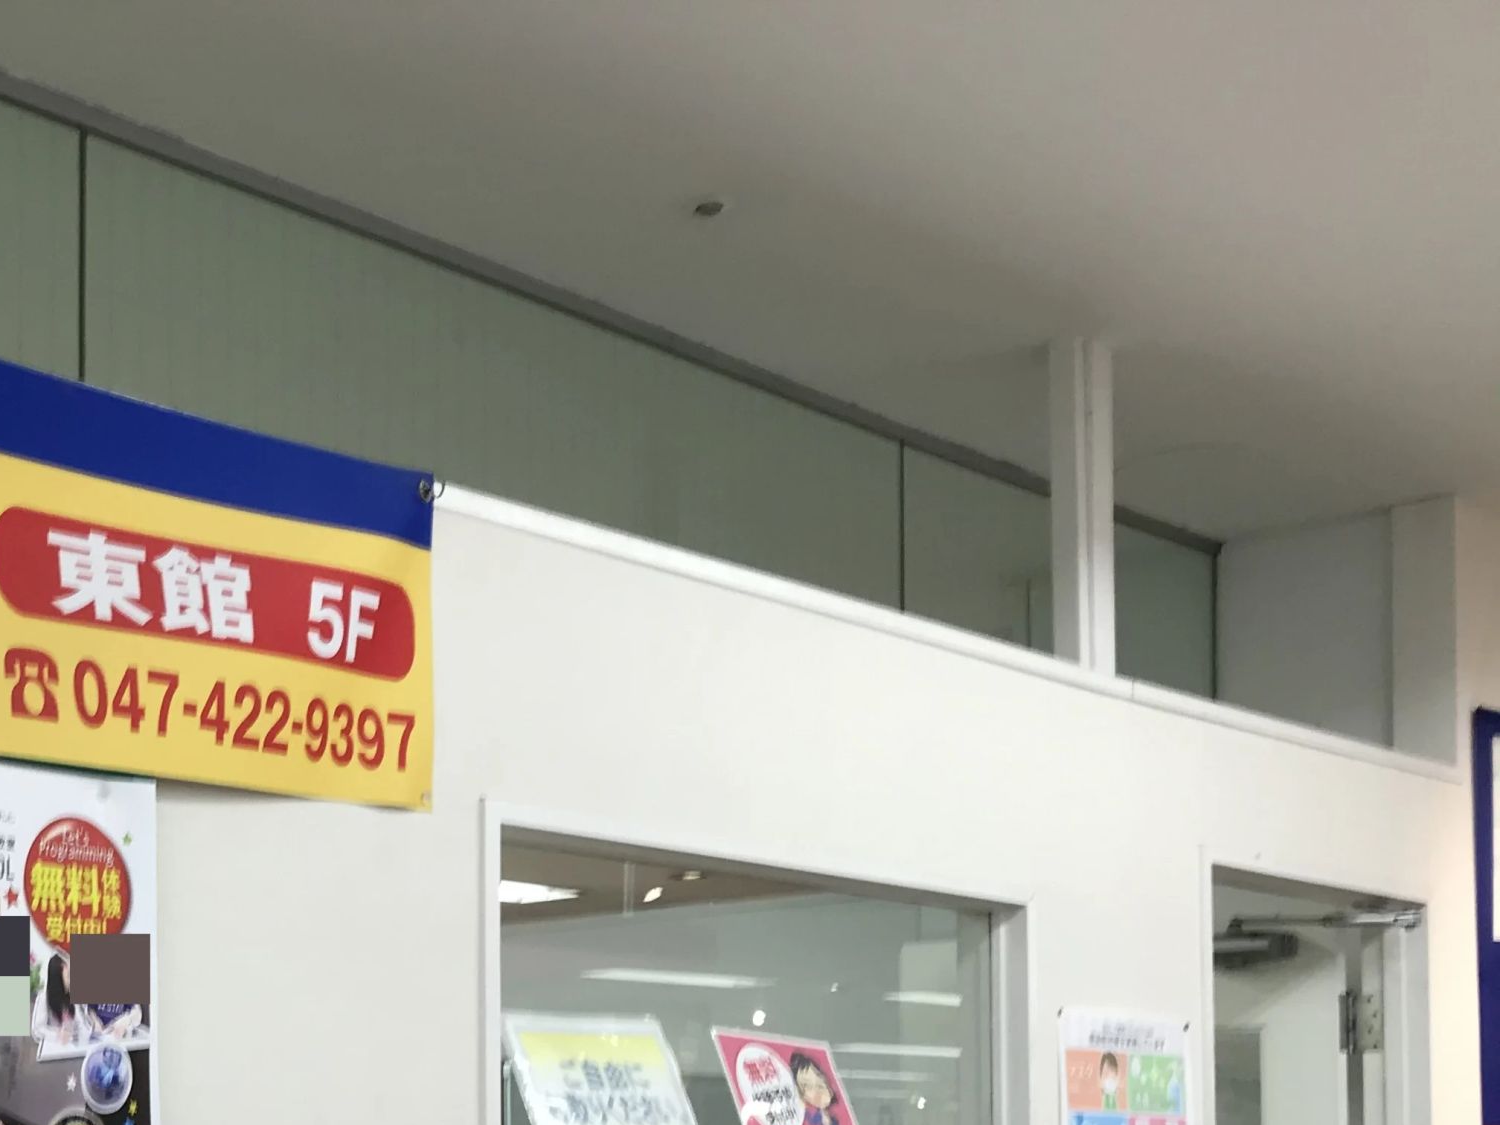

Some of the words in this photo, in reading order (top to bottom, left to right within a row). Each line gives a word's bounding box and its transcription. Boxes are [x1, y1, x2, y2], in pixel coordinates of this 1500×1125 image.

[46, 528, 255, 644] 東館
[306, 582, 381, 666] 5F
[73, 659, 416, 771] 047-422-9397
[30, 859, 102, 918] 無料
